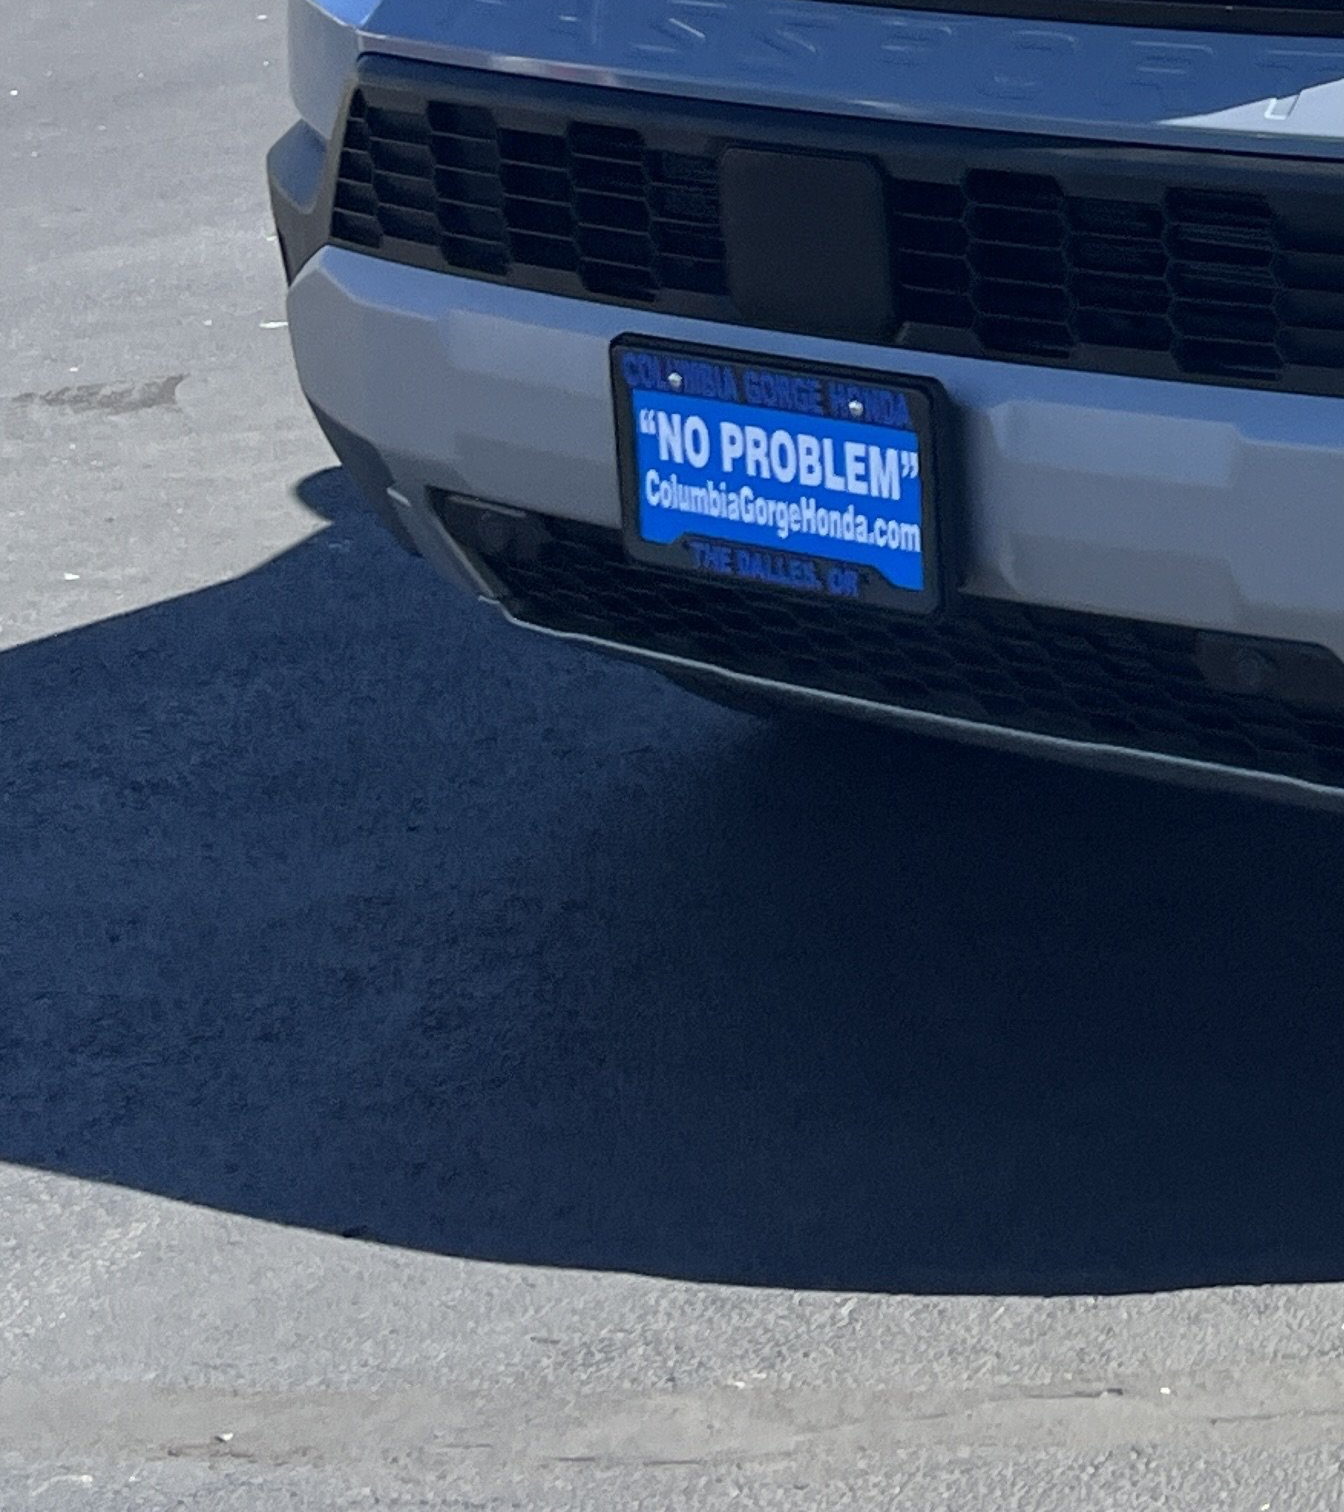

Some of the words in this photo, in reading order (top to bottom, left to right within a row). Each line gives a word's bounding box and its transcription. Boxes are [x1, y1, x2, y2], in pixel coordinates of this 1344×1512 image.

[742, 368, 824, 415] GORGE
[638, 407, 711, 469] “NO
[719, 421, 919, 501] PROBLEM”
[644, 468, 922, 553] ColumbiaGorgeHonda.com
[688, 540, 732, 574] THE
